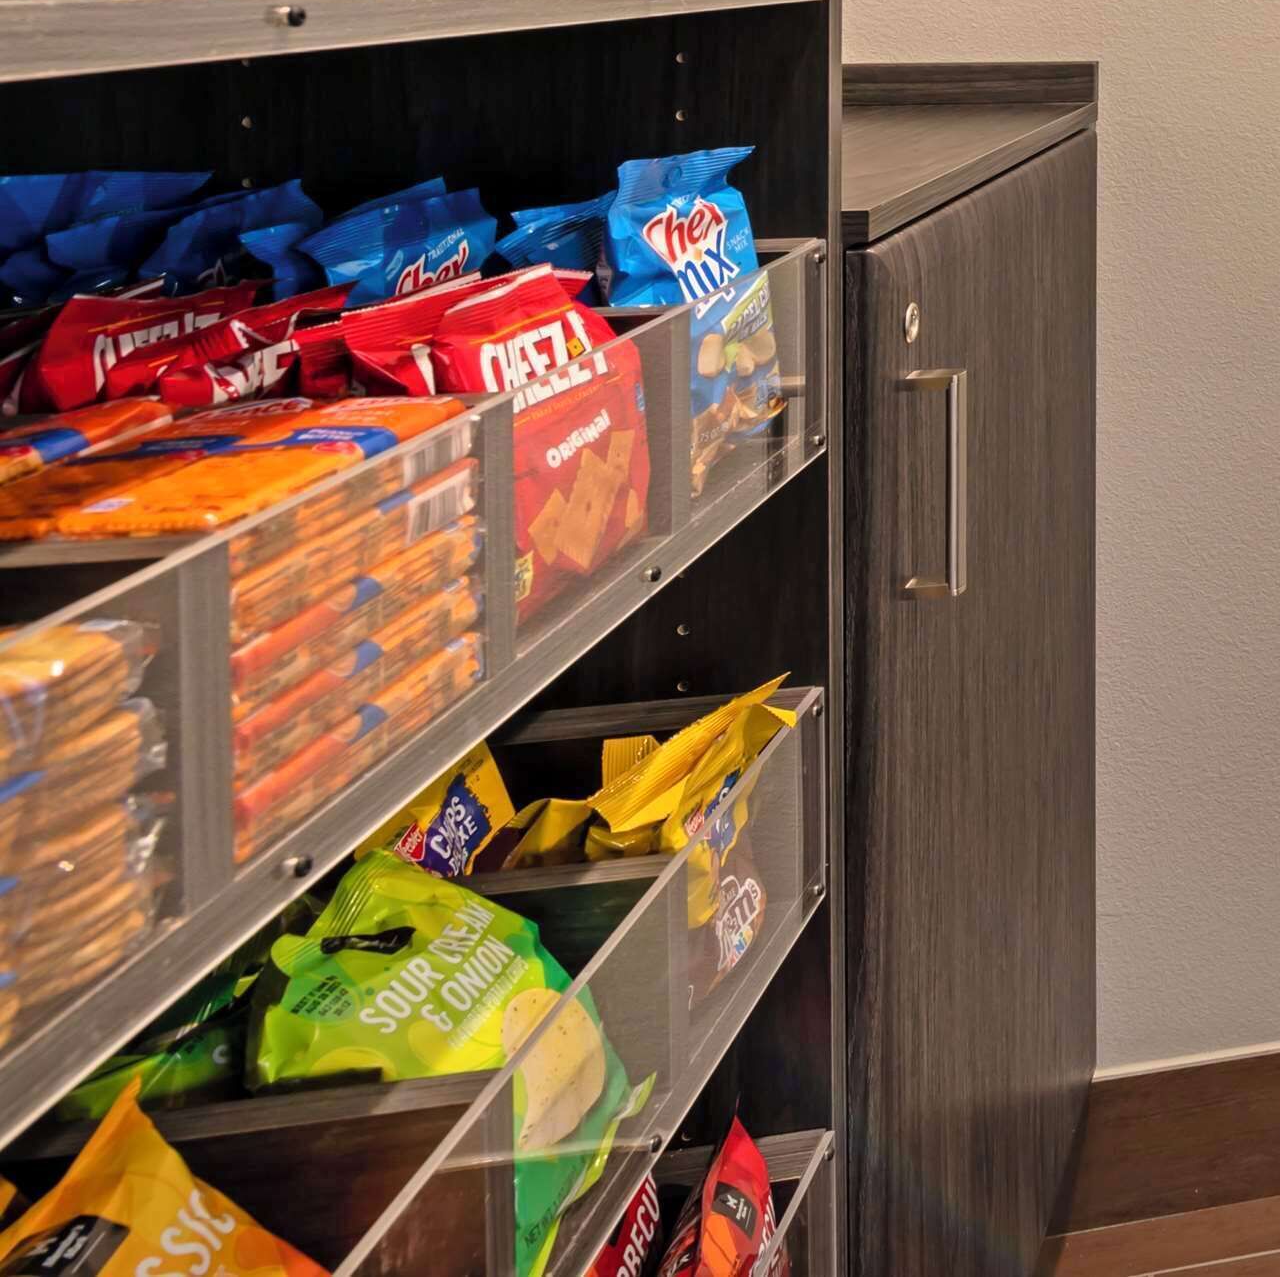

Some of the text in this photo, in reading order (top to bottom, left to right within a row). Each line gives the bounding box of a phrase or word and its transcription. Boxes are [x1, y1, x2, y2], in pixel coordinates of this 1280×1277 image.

[427, 226, 465, 261] TRADITIONAL
[647, 197, 726, 265] Chex
[726, 228, 751, 251] SNACK
[734, 240, 750, 254] MIX
[430, 795, 466, 860] CHIPS
[359, 956, 445, 1035] SOUR
[427, 898, 495, 965] CREAM
[420, 1003, 454, 1033] &
[440, 934, 515, 1012] ONION
